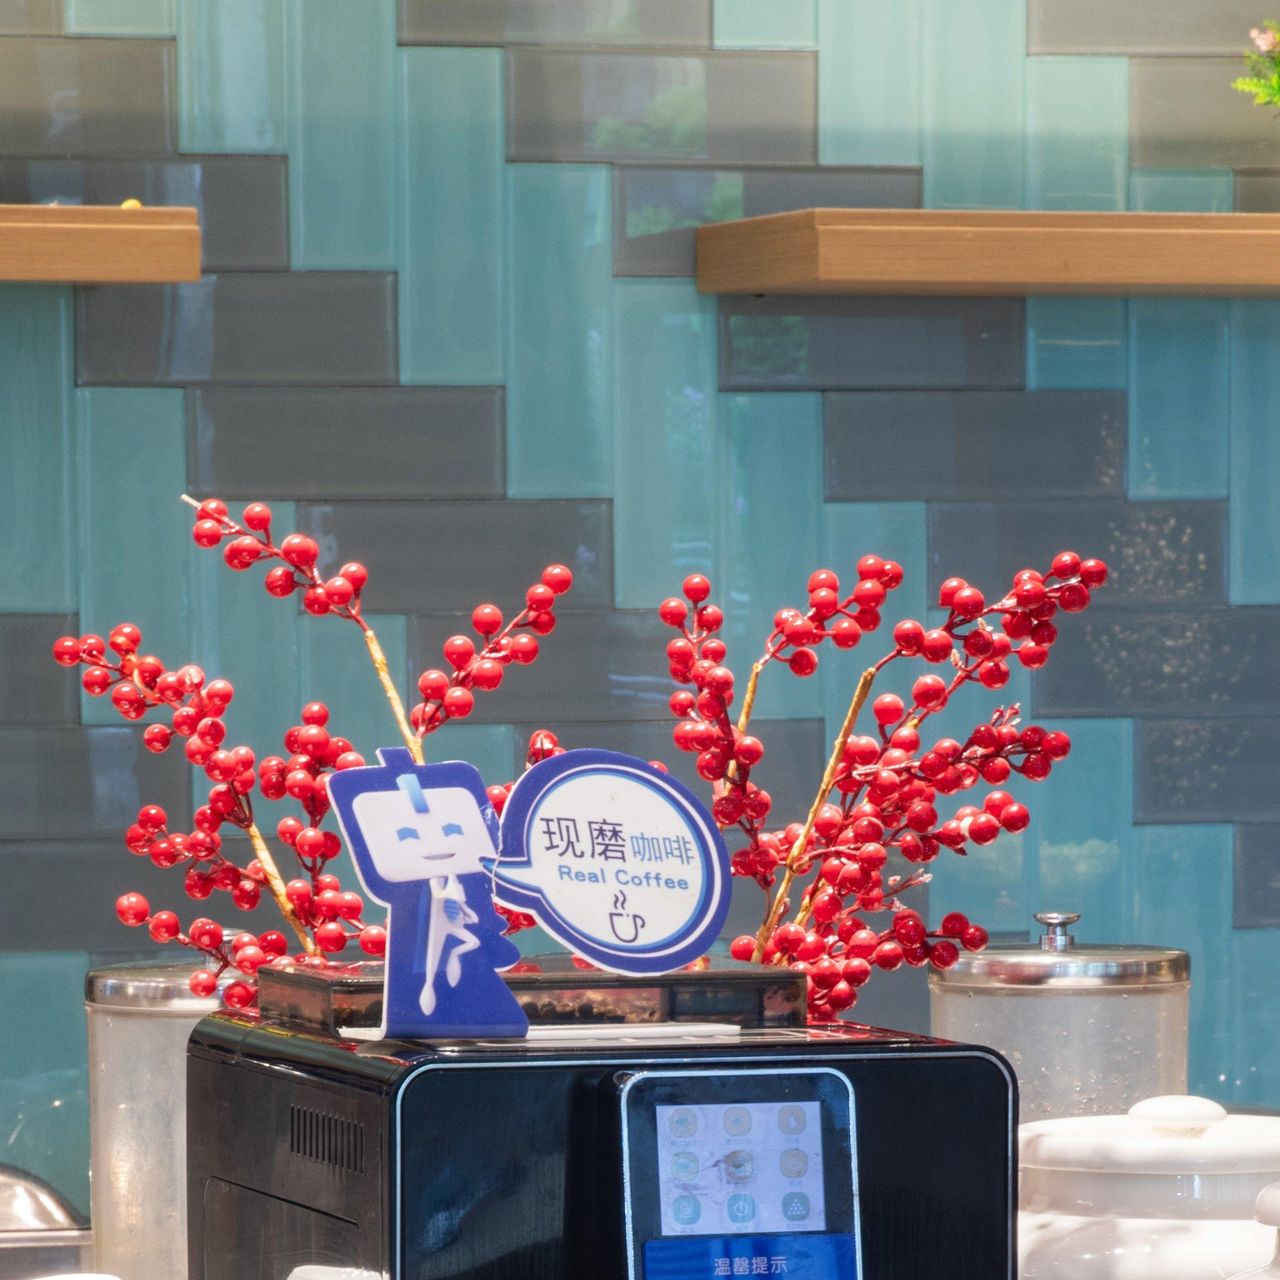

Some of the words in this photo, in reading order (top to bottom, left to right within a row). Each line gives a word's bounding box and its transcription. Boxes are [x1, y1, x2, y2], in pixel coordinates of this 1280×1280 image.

[539, 817, 694, 865] 现磨咖啡
[558, 864, 607, 885] Real
[614, 868, 690, 890] Coffee
[713, 1255, 788, 1276] 温馨提示
